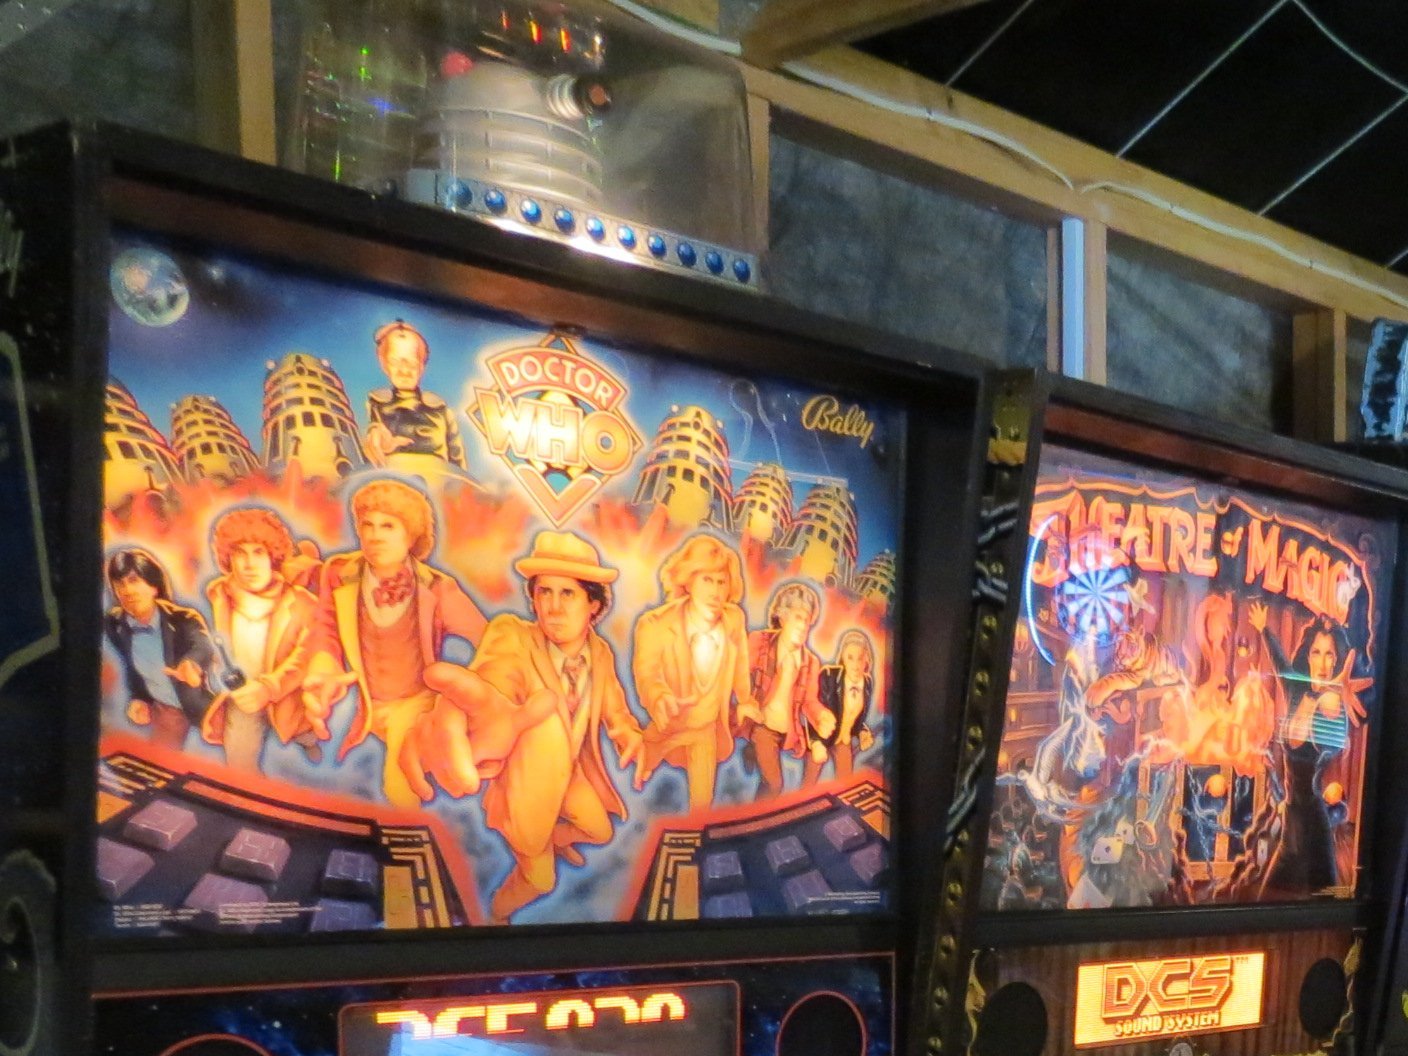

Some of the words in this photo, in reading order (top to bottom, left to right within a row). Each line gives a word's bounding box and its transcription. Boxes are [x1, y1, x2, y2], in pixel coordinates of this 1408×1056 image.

[501, 356, 614, 401] DOCTOR
[474, 386, 635, 476] WHO
[802, 394, 873, 448] Bally
[1029, 489, 1218, 588] THEATRE
[1245, 517, 1358, 625] MAGIC
[1101, 955, 1234, 1022] DCS
[1113, 1013, 1163, 1037] SOUND
[1163, 1009, 1222, 1031] SYSTEM
